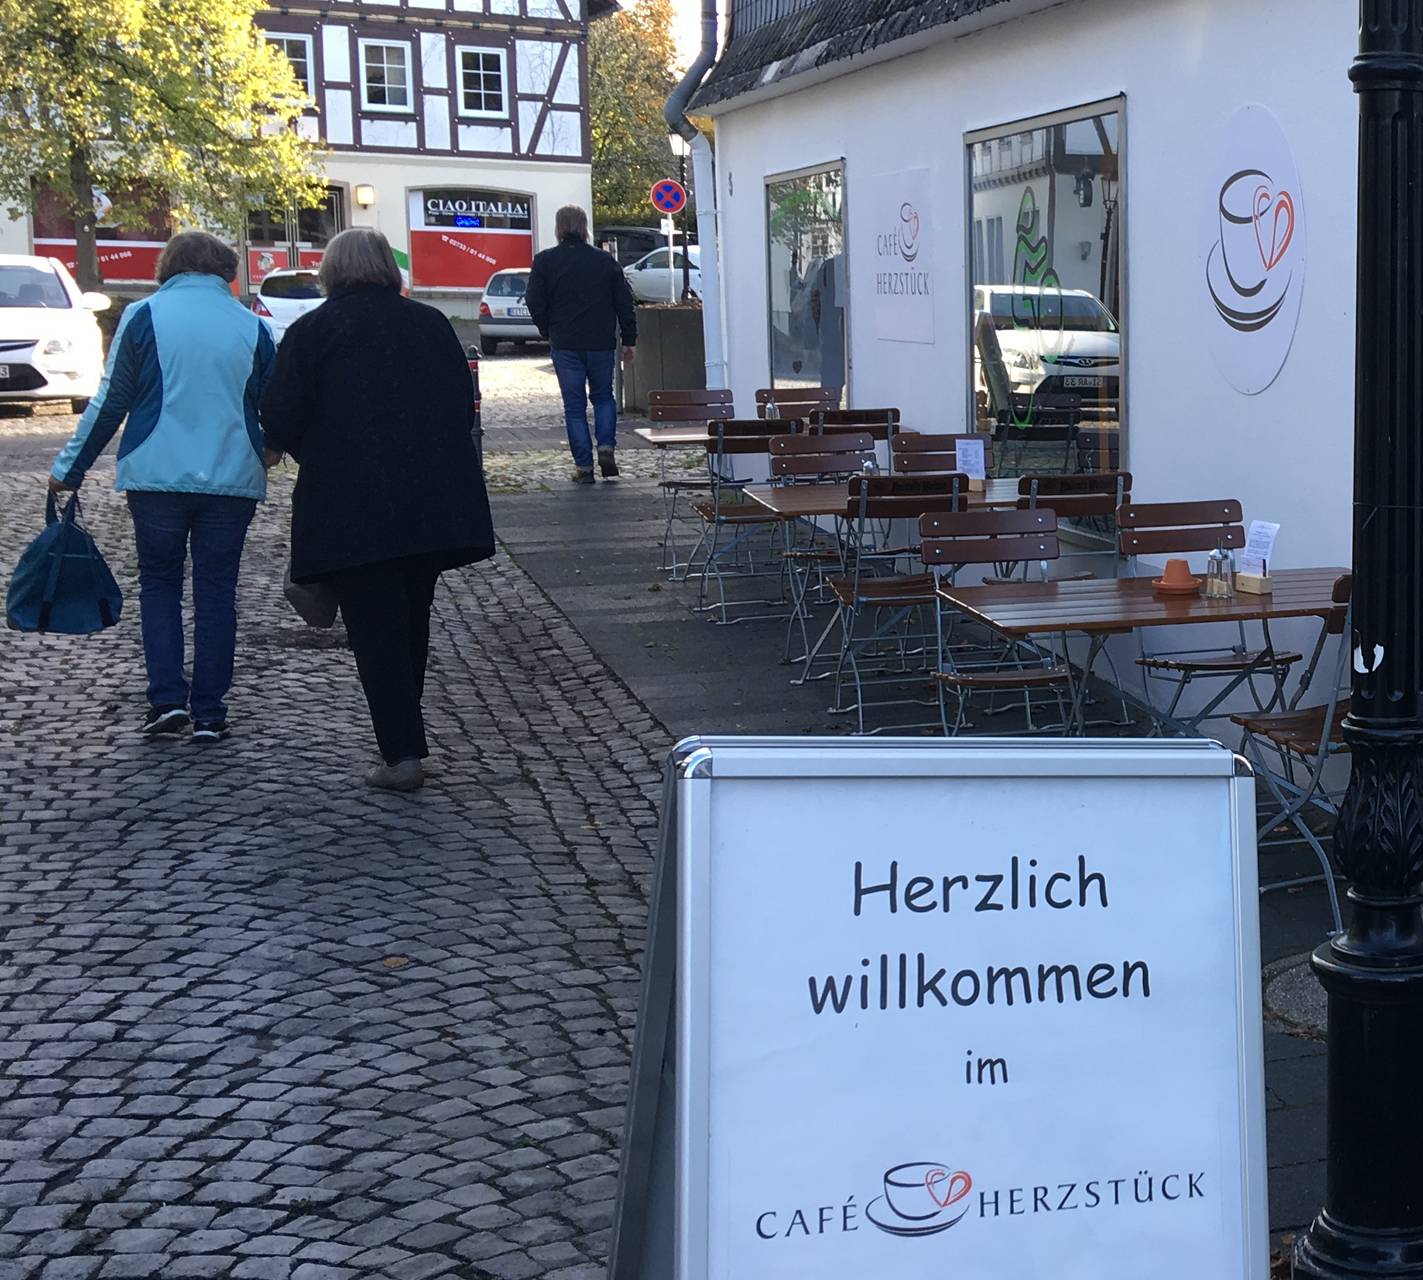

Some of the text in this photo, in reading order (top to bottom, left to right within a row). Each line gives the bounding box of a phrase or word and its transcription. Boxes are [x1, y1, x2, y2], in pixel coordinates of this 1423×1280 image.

[427, 199, 528, 215] CIAO ITALIA!
[877, 226, 898, 256] CAFÉ
[876, 266, 929, 295] HERZSTÜCK
[854, 855, 1108, 916] Herzlich
[809, 953, 1150, 1014] willkommen
[966, 1050, 1008, 1085] im
[756, 1171, 1204, 1239] CAFÉ HERZSTÜCK
